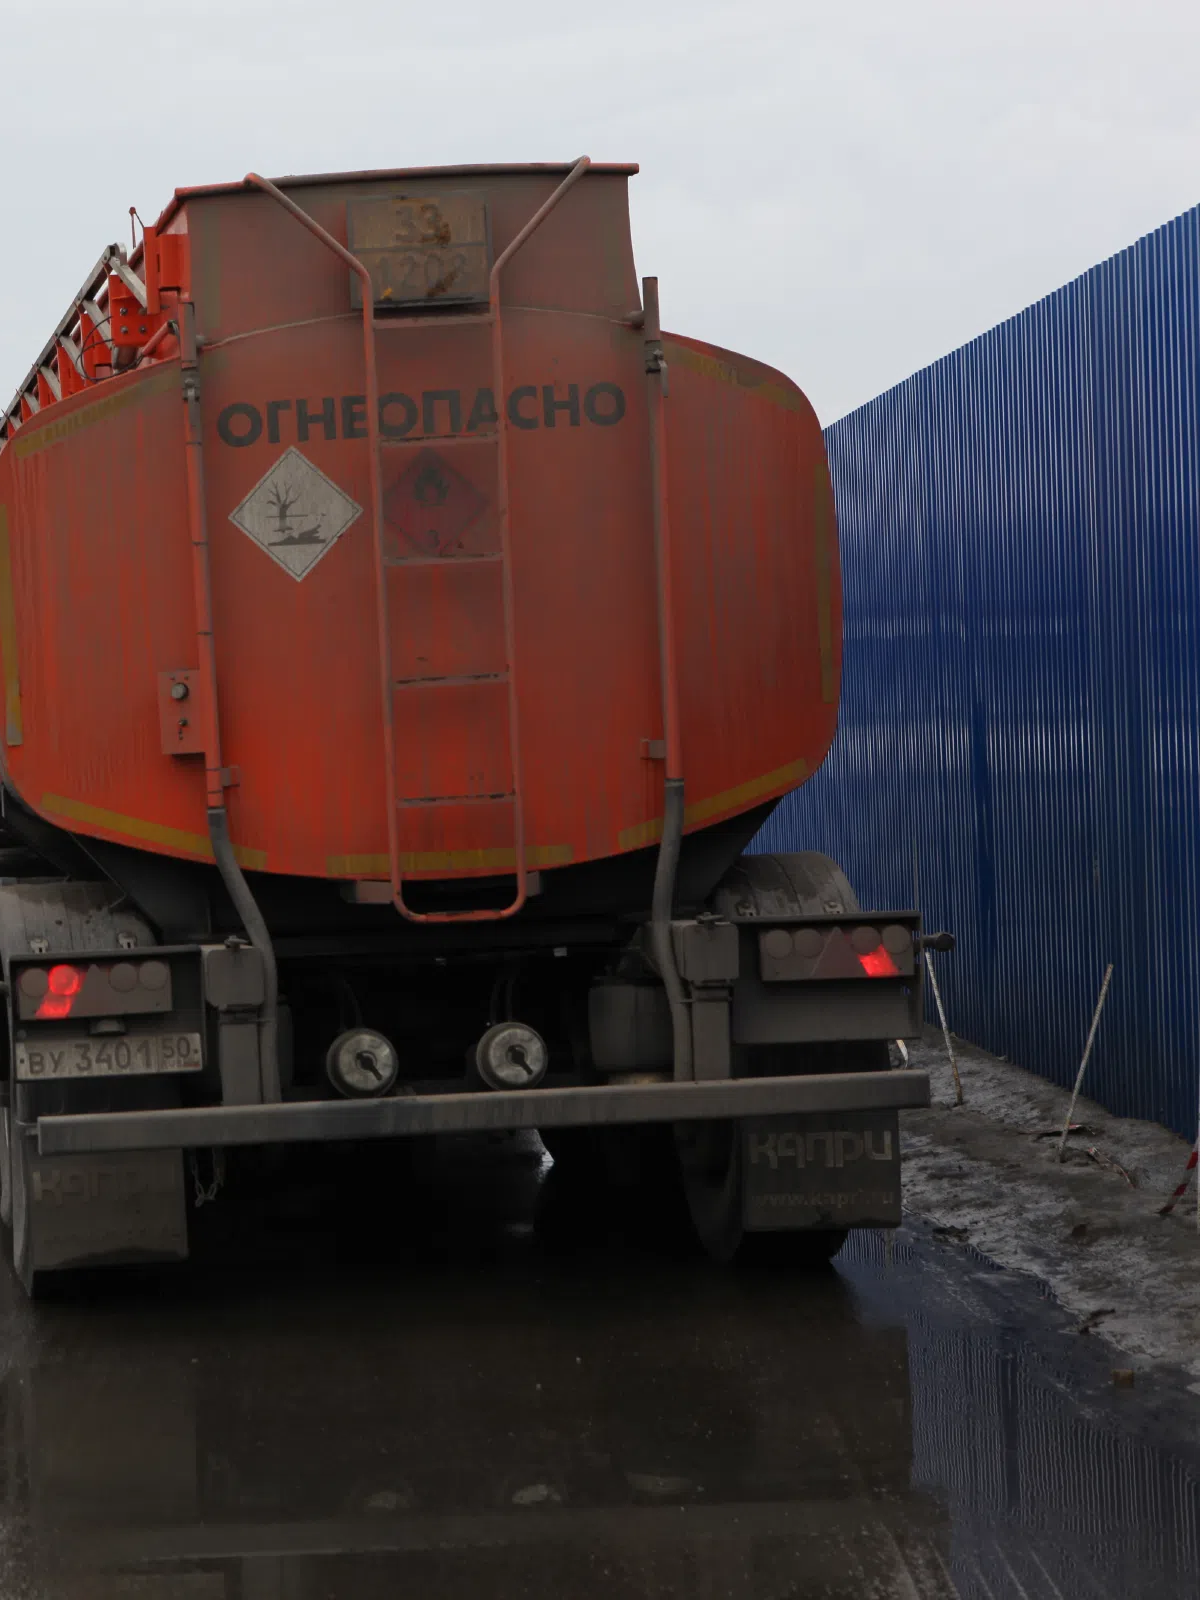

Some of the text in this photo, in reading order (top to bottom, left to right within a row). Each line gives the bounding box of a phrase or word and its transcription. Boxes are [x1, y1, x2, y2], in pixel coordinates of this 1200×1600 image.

[216, 382, 627, 447] ОГНЕОПАСНО
[74, 1040, 151, 1072] 3401
[161, 1036, 191, 1059] 50
